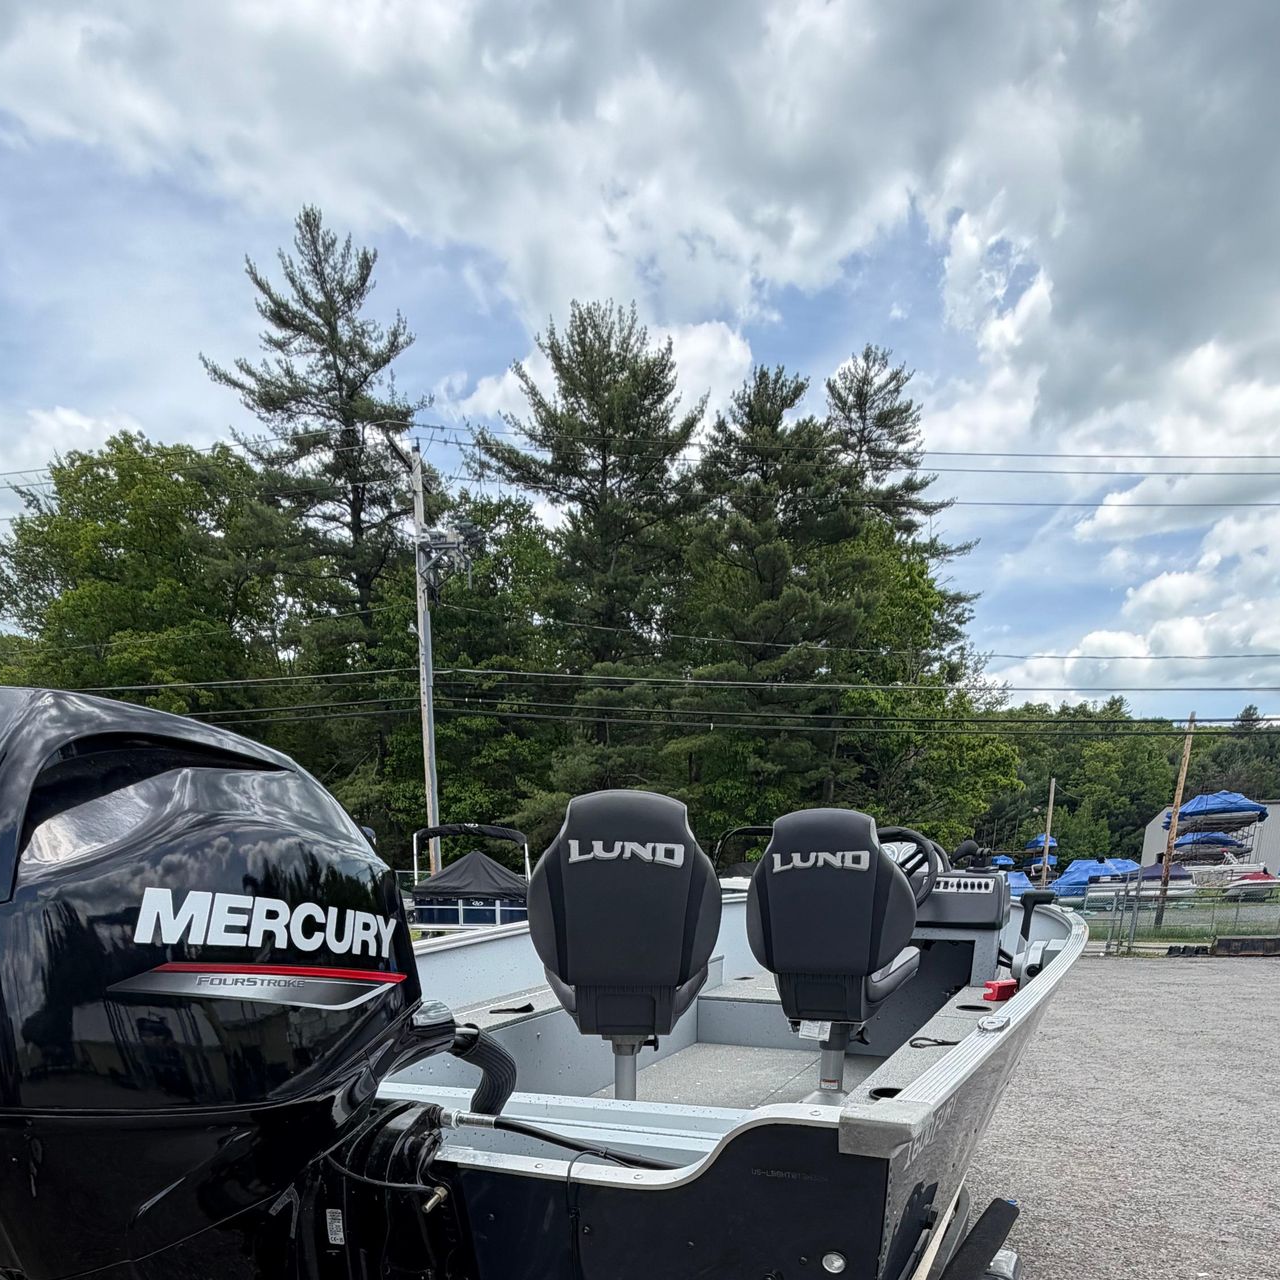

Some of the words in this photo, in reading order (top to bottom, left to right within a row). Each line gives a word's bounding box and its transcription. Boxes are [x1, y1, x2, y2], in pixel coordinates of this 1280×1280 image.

[568, 839, 685, 869] LUND
[772, 850, 870, 874] LUND
[133, 887, 397, 959] MERCURY
